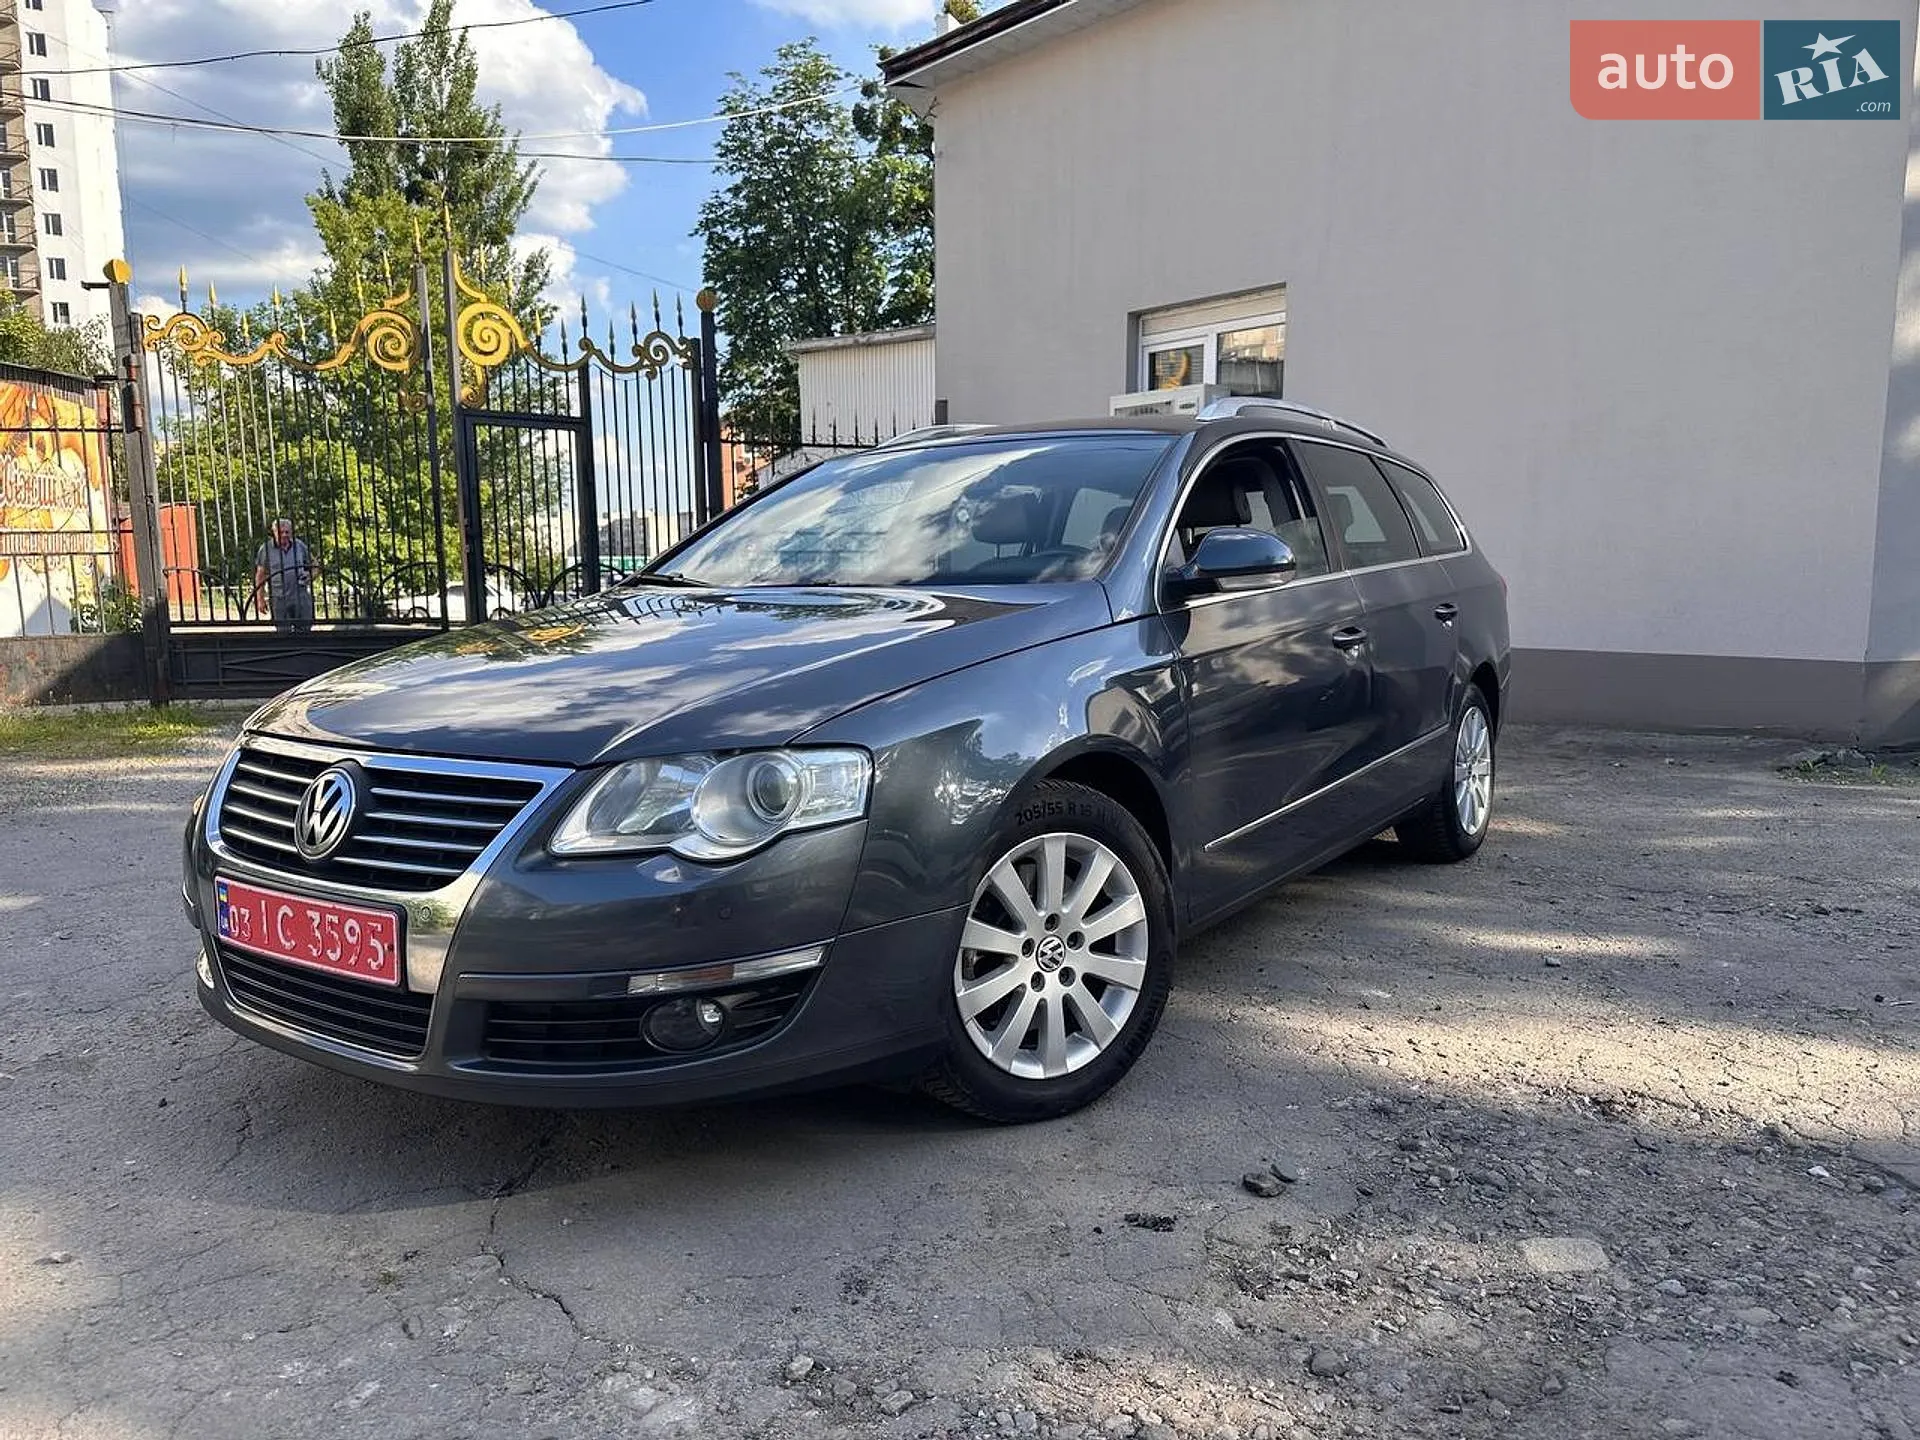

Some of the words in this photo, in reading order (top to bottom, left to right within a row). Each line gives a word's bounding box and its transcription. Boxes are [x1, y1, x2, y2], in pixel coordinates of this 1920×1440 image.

[1014, 800, 1064, 825] 205/55
[229, 904, 251, 941] 03
[306, 909, 384, 971] 3595
